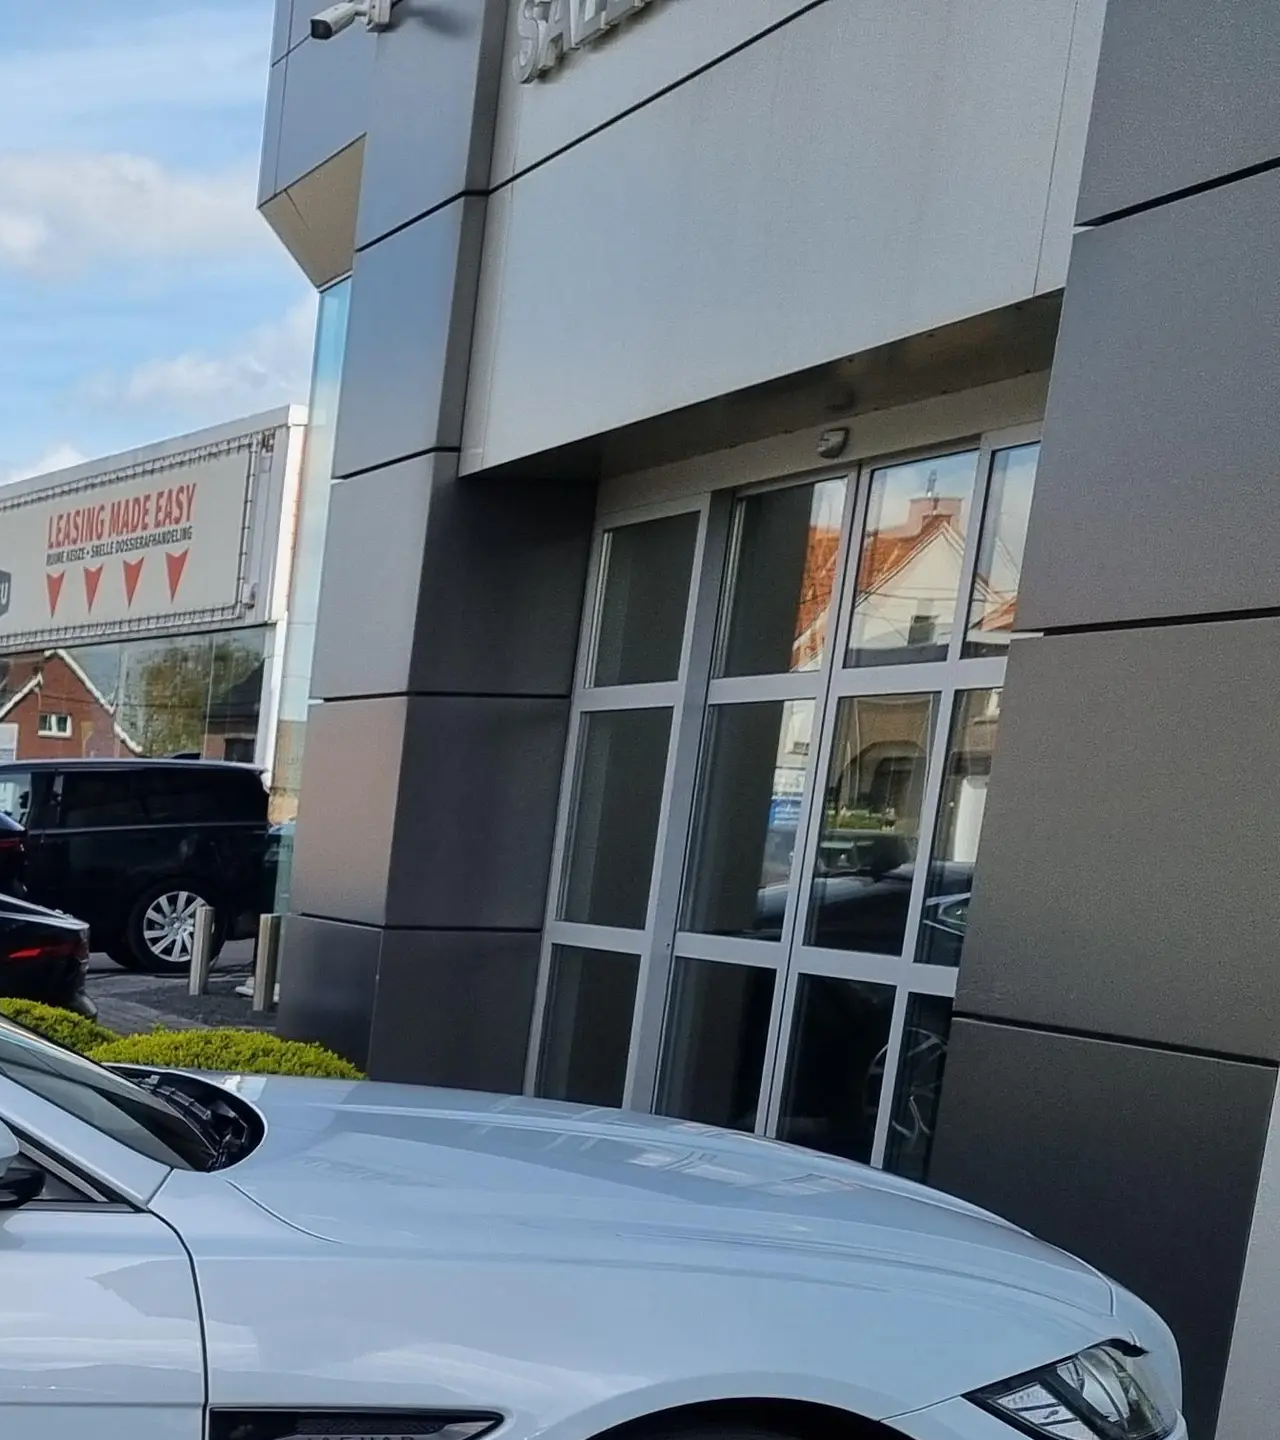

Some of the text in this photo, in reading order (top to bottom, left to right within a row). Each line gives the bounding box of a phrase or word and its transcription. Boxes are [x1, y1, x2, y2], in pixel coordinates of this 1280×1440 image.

[47, 483, 197, 549] LEASING MADE EASY
